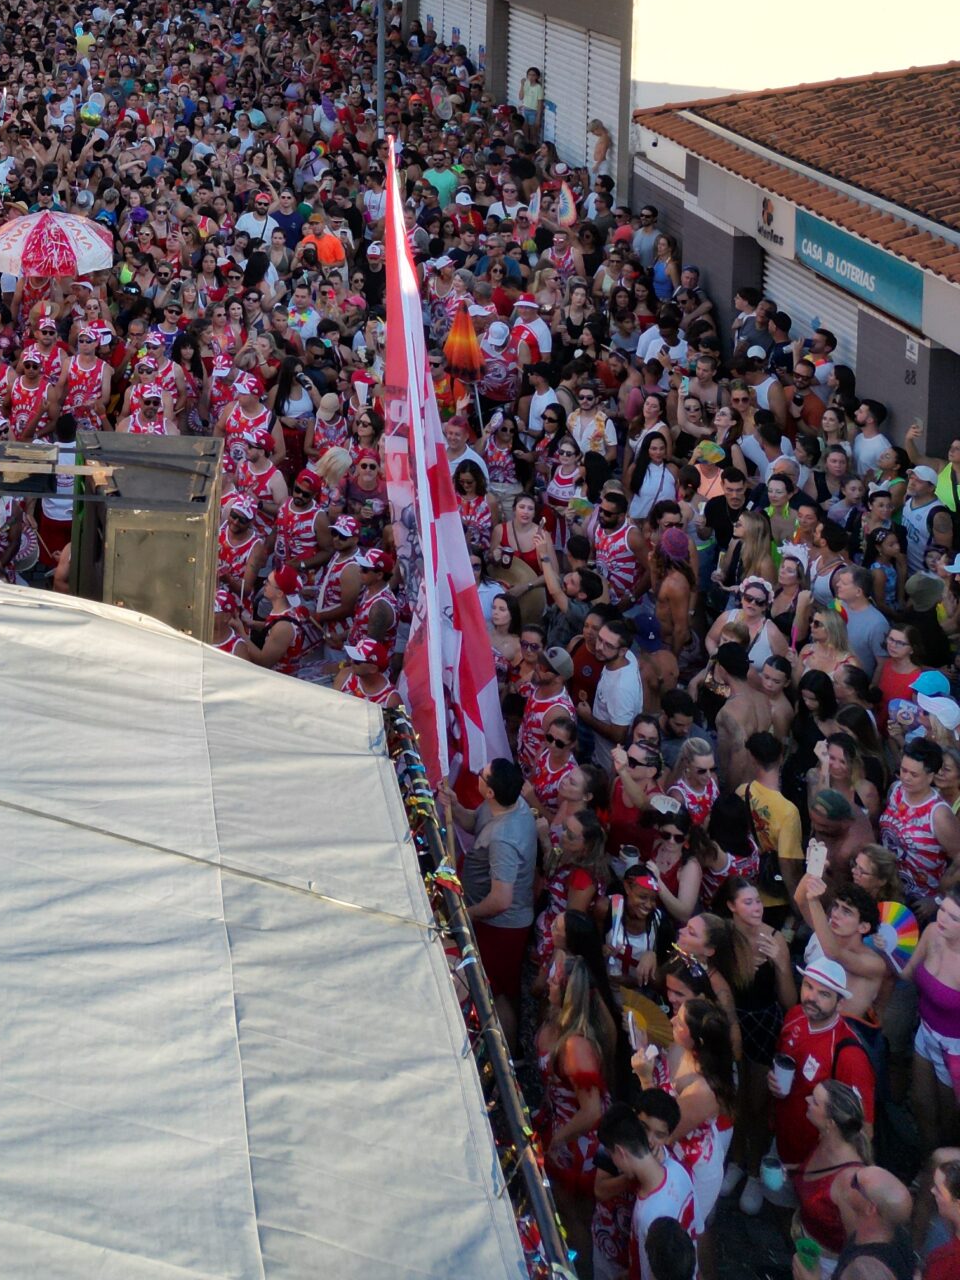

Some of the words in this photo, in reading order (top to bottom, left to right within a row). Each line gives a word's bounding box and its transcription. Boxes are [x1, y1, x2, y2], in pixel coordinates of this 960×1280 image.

[801, 238, 823, 264] CASA
[825, 251, 835, 269] JB
[835, 257, 876, 292] LOTERIAS
[904, 369, 917, 386] 88
